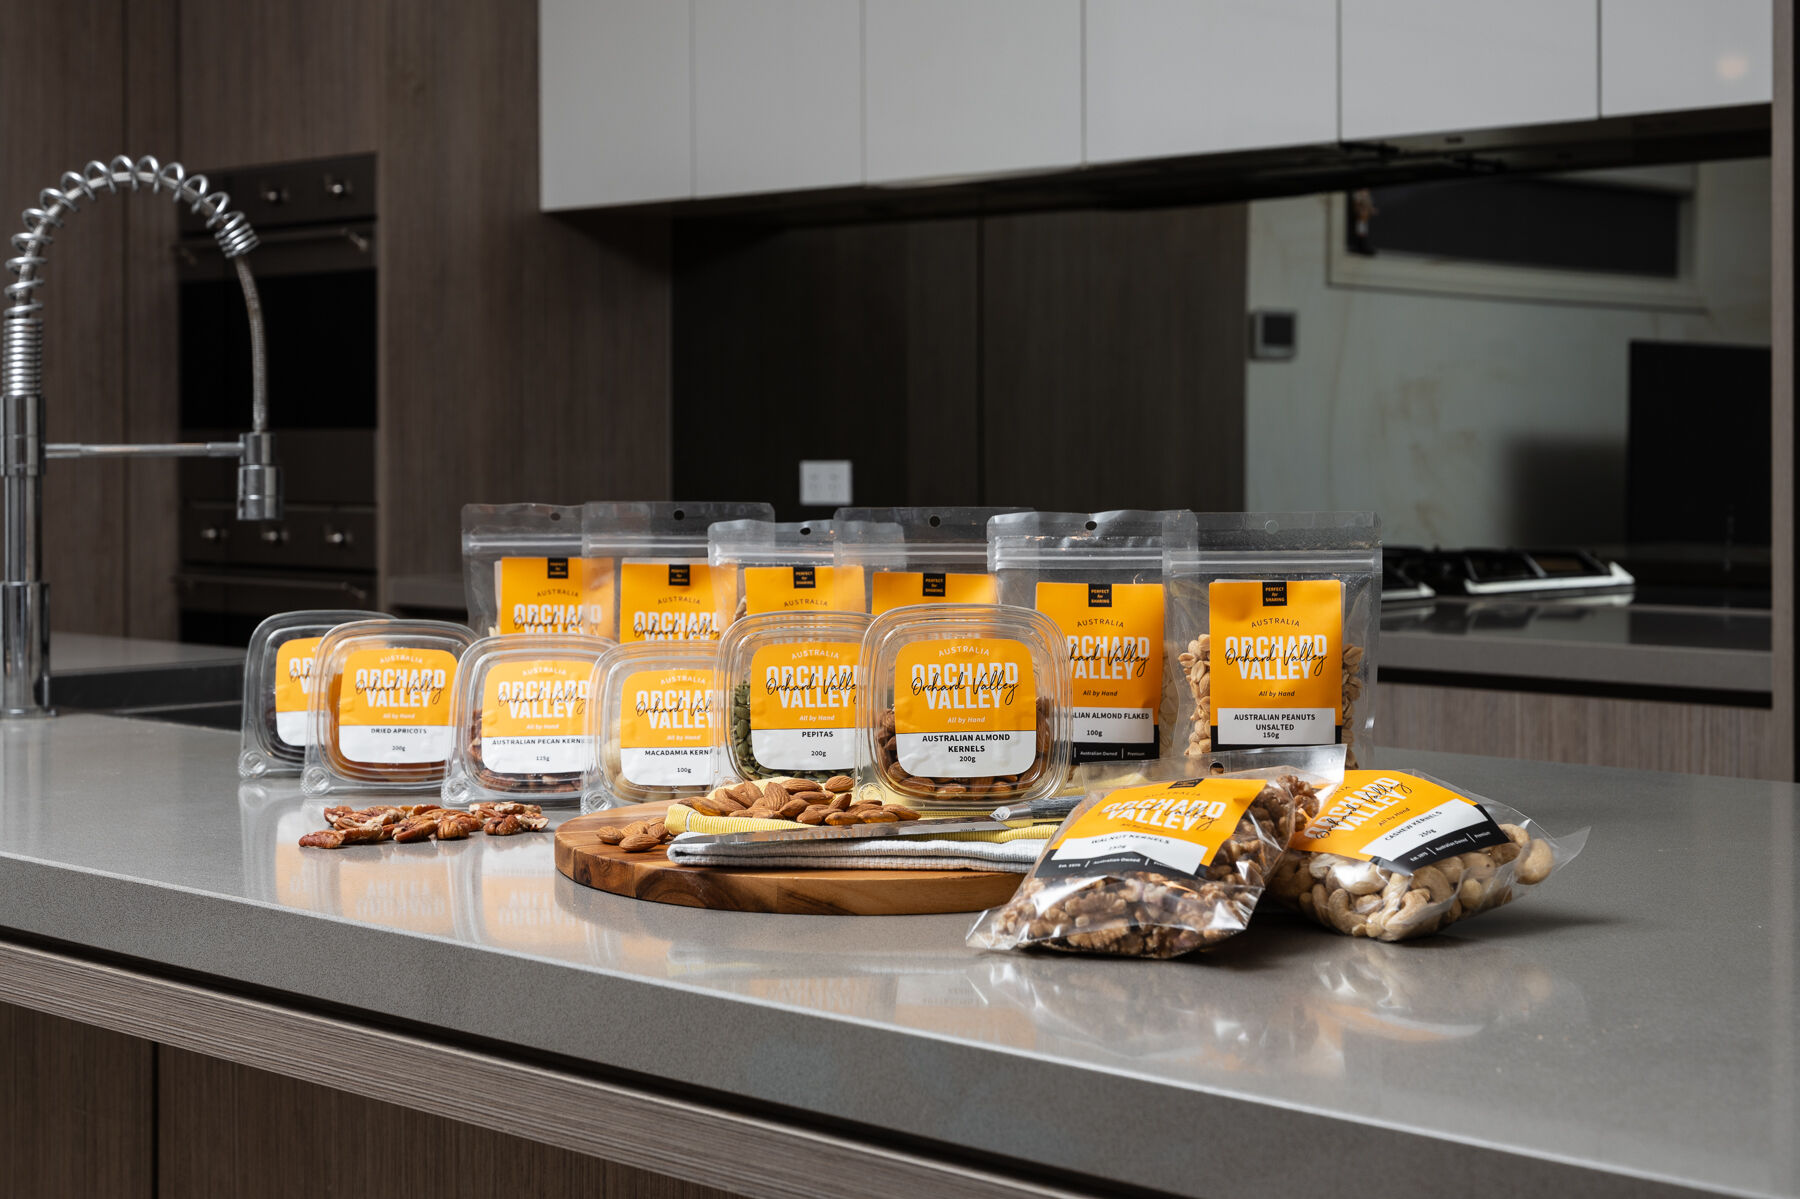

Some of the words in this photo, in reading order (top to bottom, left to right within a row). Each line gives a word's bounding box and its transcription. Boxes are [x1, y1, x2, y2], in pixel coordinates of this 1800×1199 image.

[537, 588, 580, 598] AUSTRALIA
[657, 596, 701, 605] AUSTRALIA
[784, 599, 828, 608] AUSTRALIA
[1077, 618, 1124, 628] AUSTRALIA
[1251, 618, 1300, 628] AUSTRALIA
[938, 645, 990, 657] AUSTRALIA
[1066, 635, 1150, 658] RCHARD
[1225, 634, 1327, 659] ORCHARD
[379, 654, 423, 664] AUSTRALIA
[791, 649, 839, 660] AUSTRALIA
[911, 662, 1019, 686] ORCHARD
[1237, 657, 1312, 680] VALLEY
[356, 668, 446, 689] ORCHARD
[366, 687, 432, 708] VALLEY
[636, 689, 722, 710] ORCHAR
[779, 686, 851, 709] VALLEY
[925, 685, 1002, 710] VALLEY
[1093, 690, 1100, 699] by
[1269, 690, 1277, 699] by
[508, 698, 576, 719] VALLEY
[958, 717, 966, 725] by
[1092, 712, 1122, 720] ALMOND
[1234, 713, 1280, 721] AUSTRALIAN
[1282, 713, 1316, 721] PEANUTS
[922, 734, 974, 742] AUSTRALIAN
[1087, 730, 1103, 738] 100g
[948, 745, 985, 753] KERNELS
[1102, 798, 1227, 819] ORCHARD
[1304, 777, 1400, 840] ORCHARD
[1331, 788, 1407, 831] VALLEY
[1107, 807, 1200, 831] VALLEY
